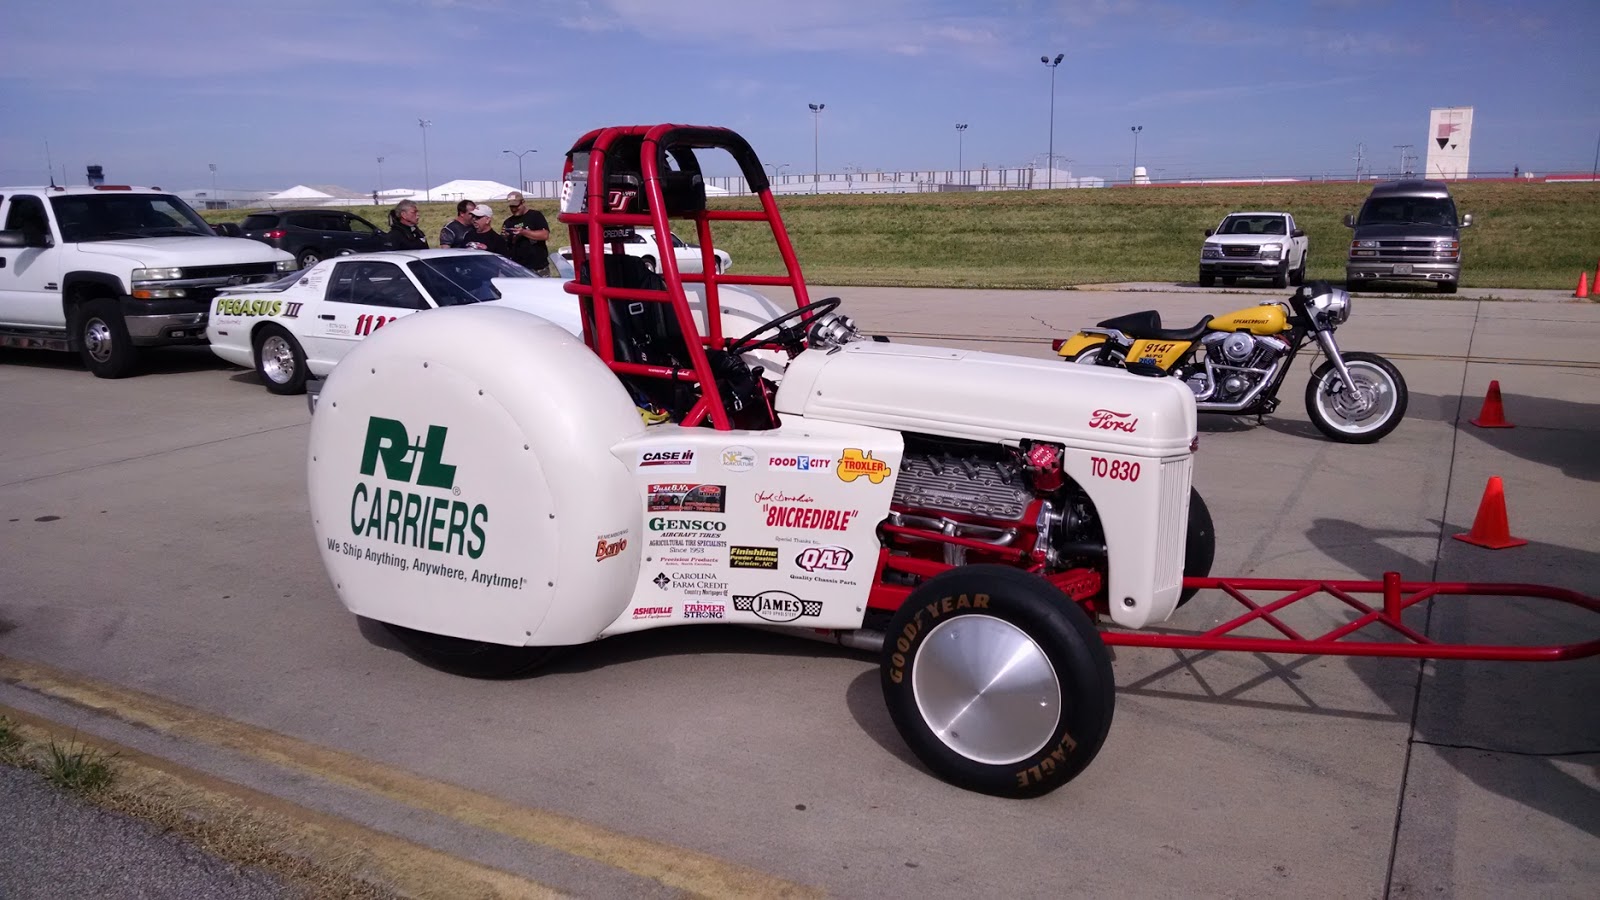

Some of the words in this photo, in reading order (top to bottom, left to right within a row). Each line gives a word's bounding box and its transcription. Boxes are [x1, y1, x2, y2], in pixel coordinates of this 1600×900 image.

[216, 298, 282, 318] PEGASUS
[282, 301, 304, 319] III
[355, 313, 399, 336] 112
[1144, 343, 1176, 353] 9147
[1088, 409, 1139, 433] Ford
[642, 452, 681, 461] CASE
[769, 457, 797, 467] FOOD
[810, 459, 831, 468] CITY
[844, 460, 884, 471] TROXLER
[1109, 459, 1140, 482] 830
[350, 482, 489, 560] CARRIERS
[649, 517, 727, 531] GENSCO
[763, 504, 859, 531] "8NCREDIBLE"
[595, 538, 628, 562] Banjo
[730, 548, 777, 557] Finishline
[327, 538, 341, 552] We
[342, 543, 363, 560] Ship
[364, 550, 410, 571] Anything,
[412, 561, 468, 582] Anywhere,
[471, 570, 524, 591] Anytime!
[800, 548, 849, 572] QA1
[672, 572, 717, 580] CAROLINA
[813, 576, 838, 584] Chassis
[672, 581, 695, 589] FARM
[696, 581, 729, 590] CREDIT
[632, 607, 673, 615] ASHEVILLE
[684, 604, 725, 612] FARMER
[757, 596, 800, 613] JAMES
[1015, 731, 1078, 789] EAGLE
